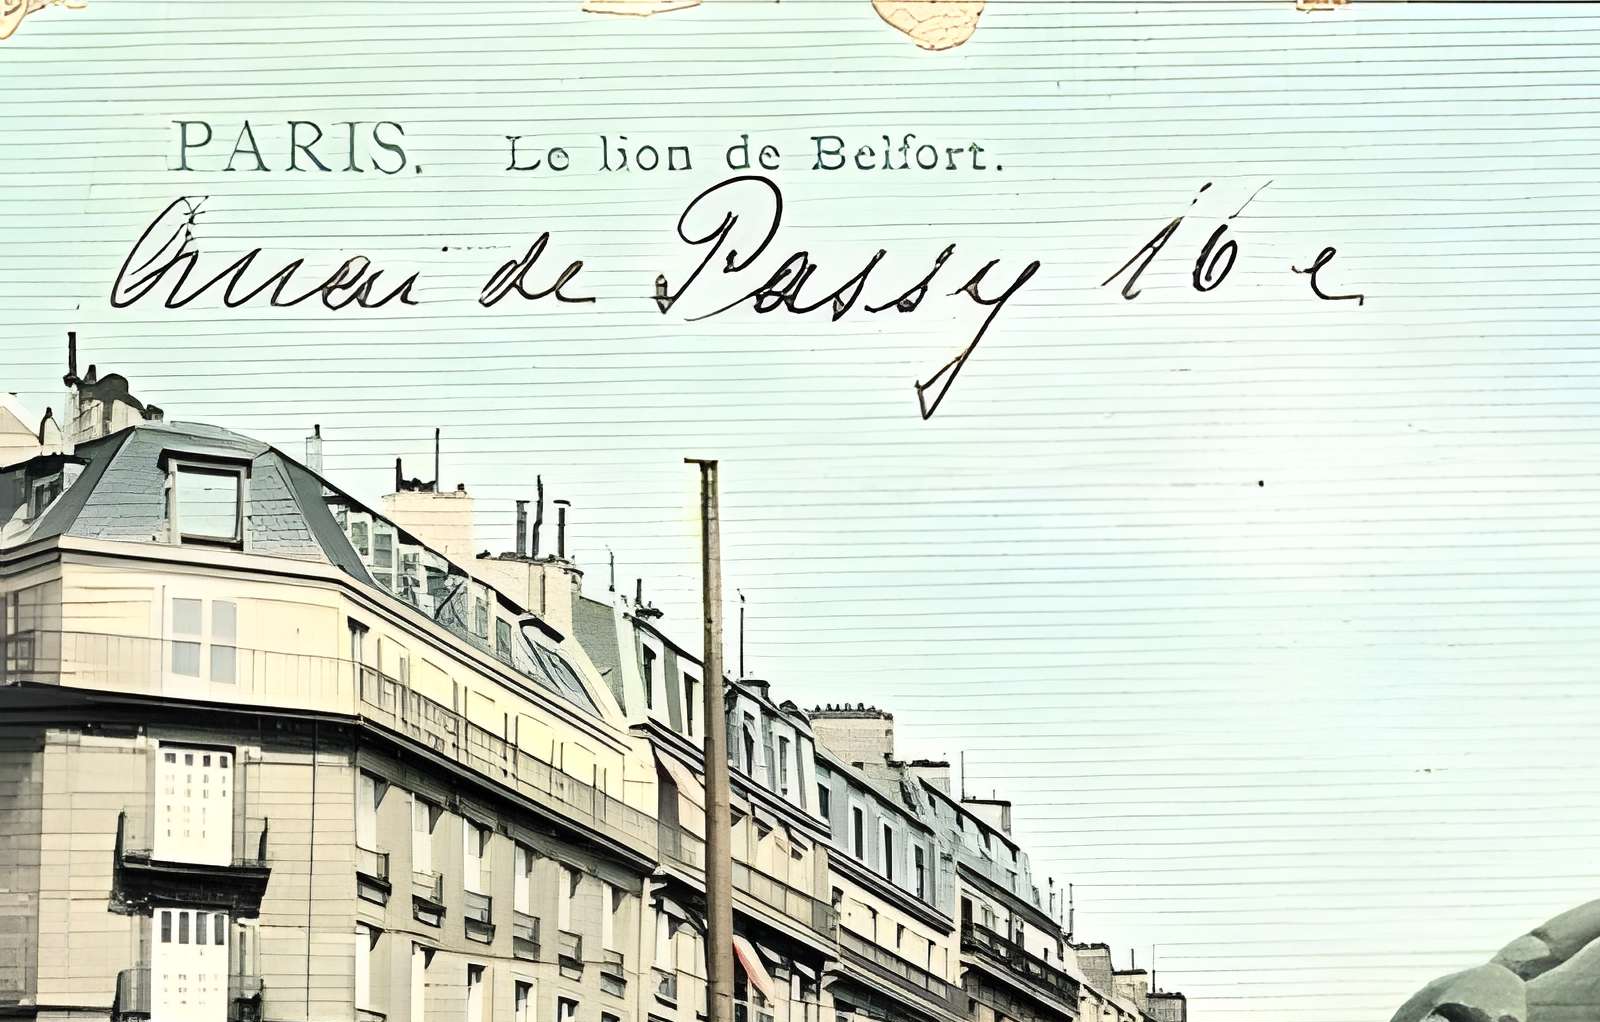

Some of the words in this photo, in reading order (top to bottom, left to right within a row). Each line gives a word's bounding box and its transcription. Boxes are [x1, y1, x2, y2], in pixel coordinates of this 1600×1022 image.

[110, 196, 449, 309] Quai
[479, 231, 597, 307] de
[656, 175, 1041, 420] Passy
